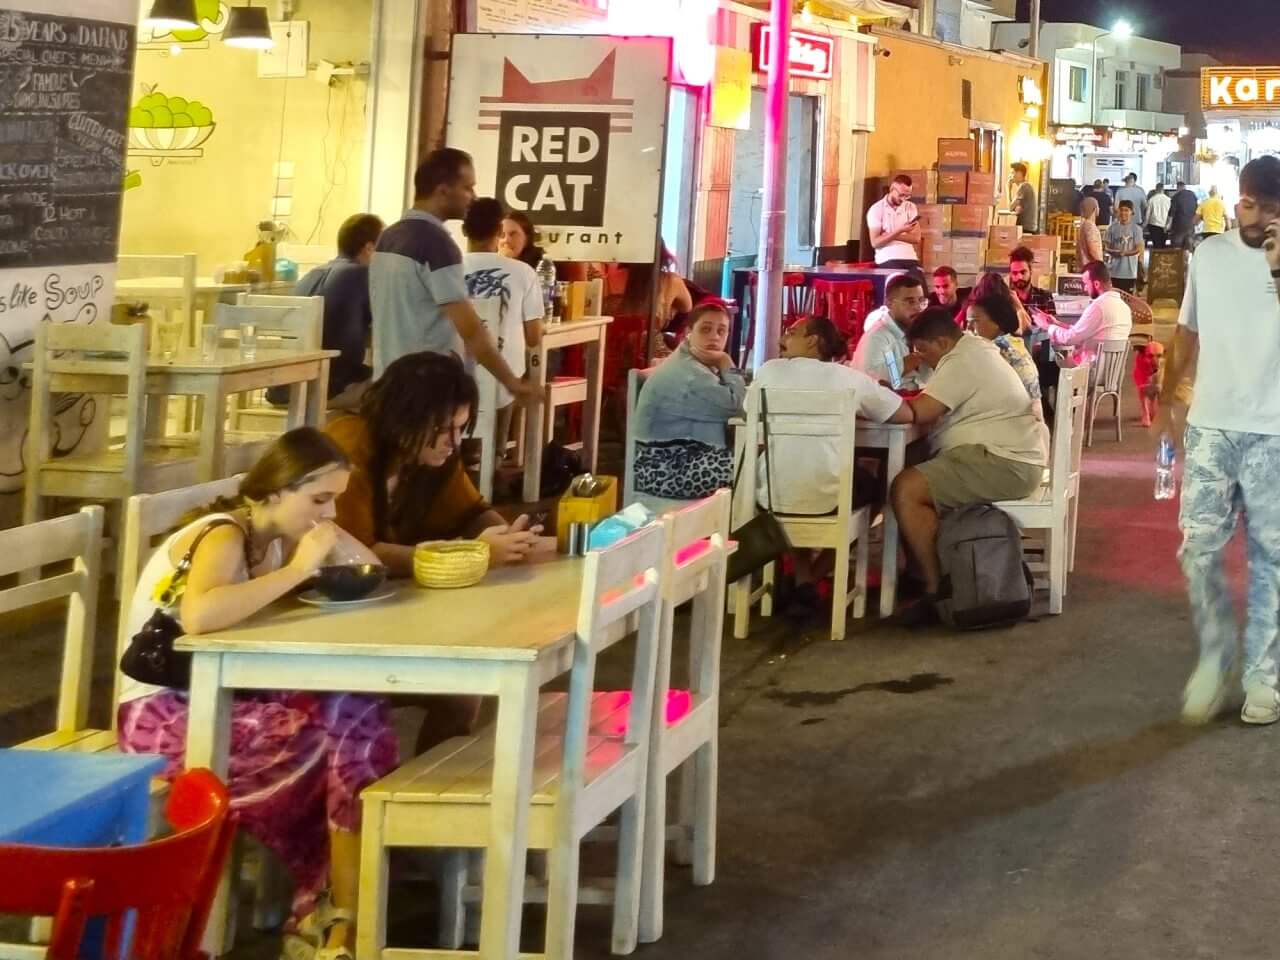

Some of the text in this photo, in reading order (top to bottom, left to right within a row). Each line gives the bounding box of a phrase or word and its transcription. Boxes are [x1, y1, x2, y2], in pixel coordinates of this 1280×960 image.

[79, 24, 129, 50] DAHAB
[510, 126, 600, 163] RED
[504, 174, 593, 211] CAT
[10, 282, 38, 310] like
